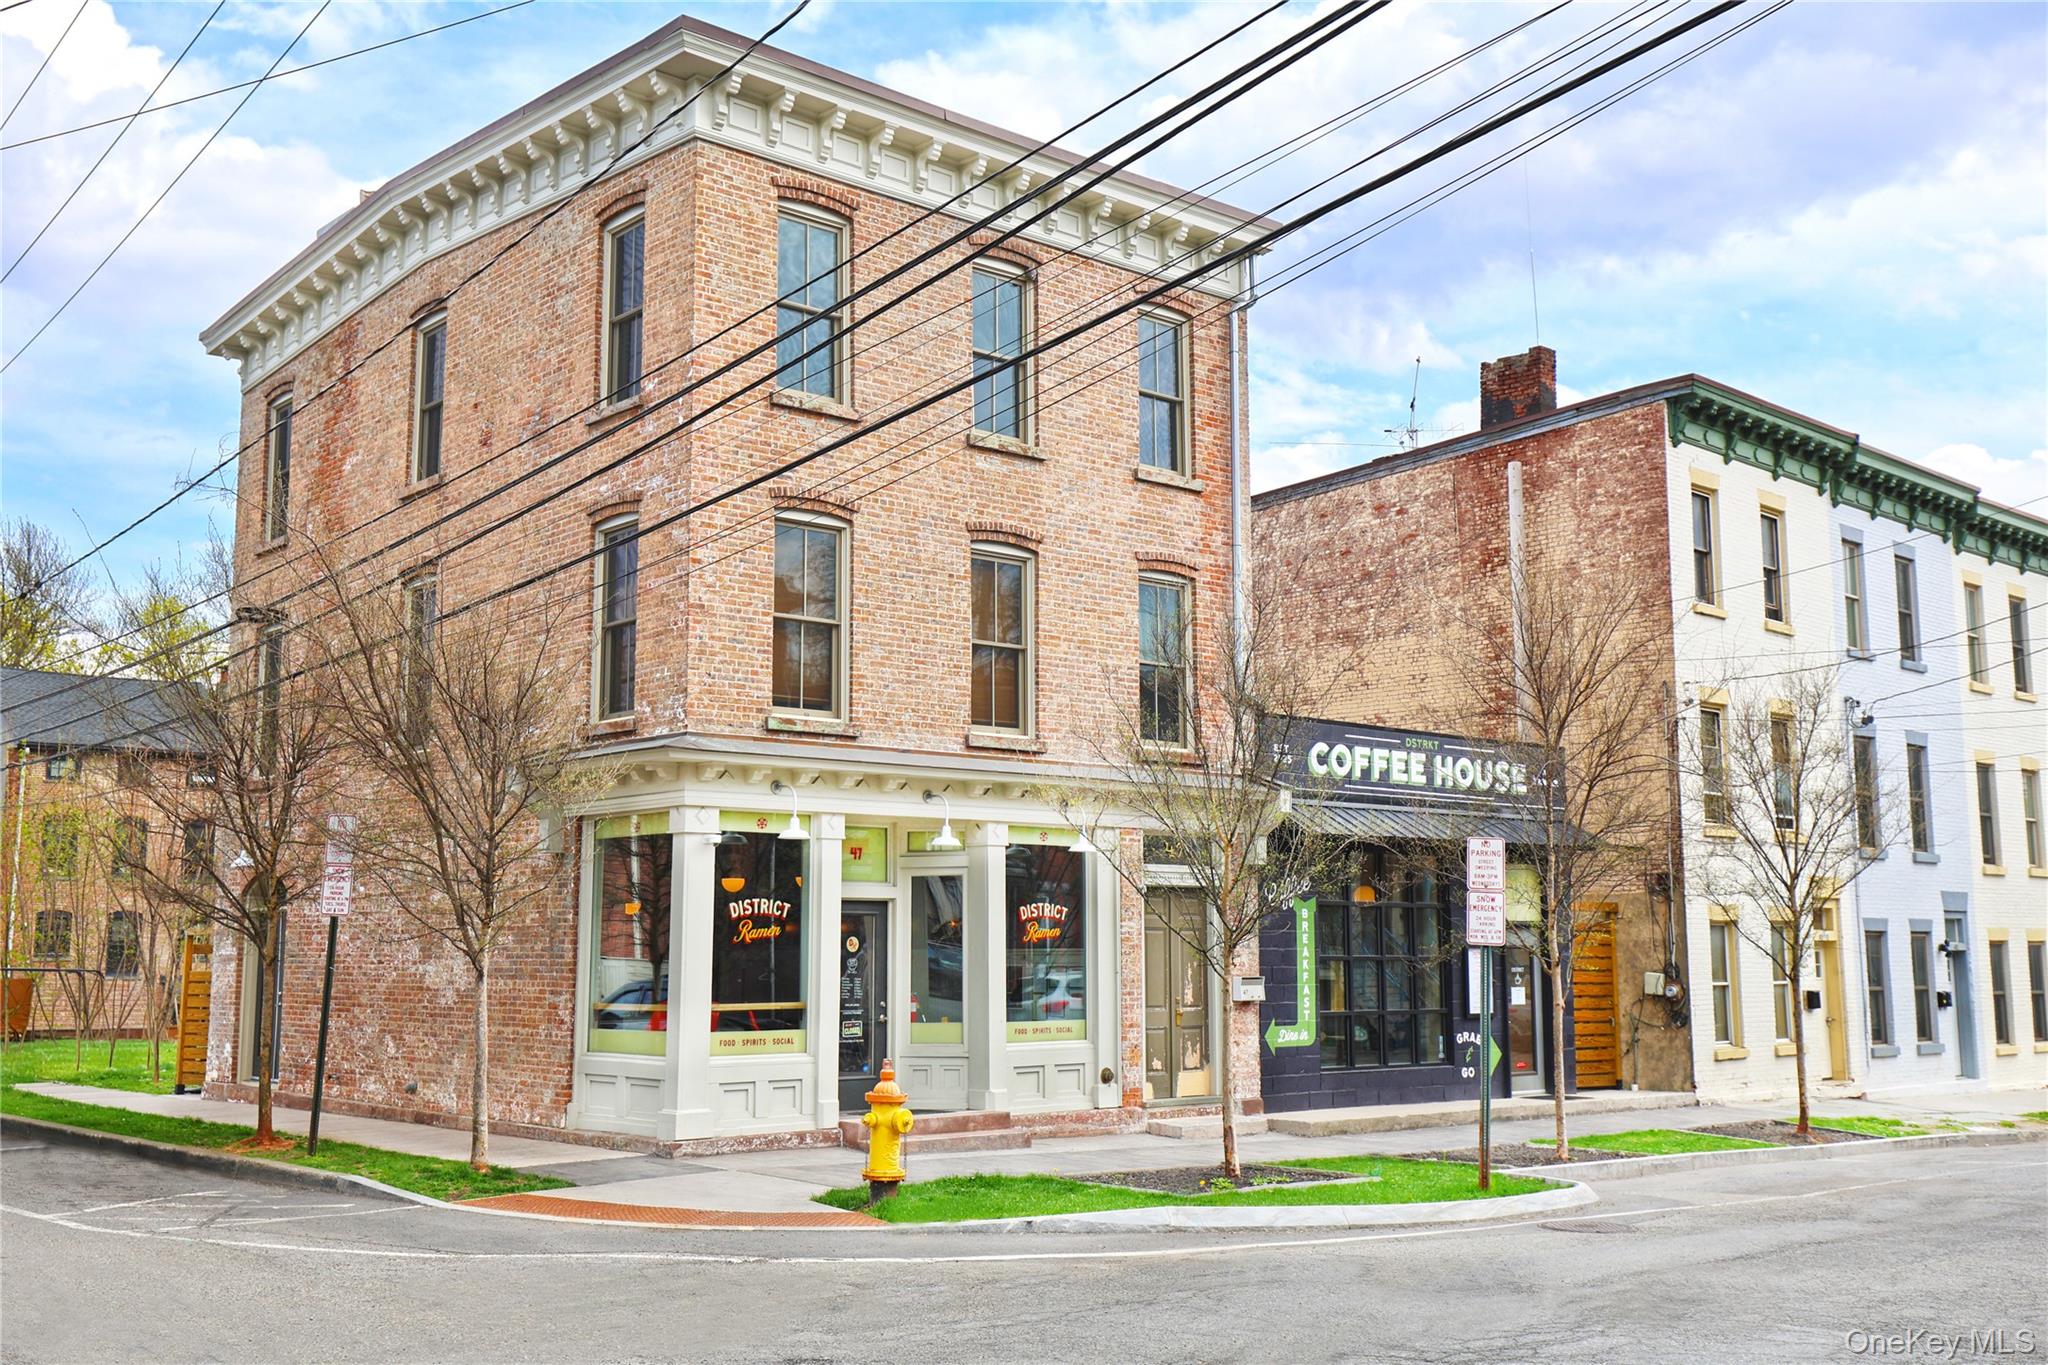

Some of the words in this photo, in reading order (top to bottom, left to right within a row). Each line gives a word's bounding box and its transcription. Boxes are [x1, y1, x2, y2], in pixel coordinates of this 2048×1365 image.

[1405, 737, 1439, 750] DSTRKT
[1308, 741, 1427, 786] COFFEE
[1433, 754, 1528, 795] HOUSE
[1480, 840, 1491, 849] NO
[849, 847, 863, 861] 47
[1470, 849, 1502, 858] PARKING
[1475, 894, 1496, 903] SNOW
[729, 898, 792, 919] DISTRICT
[1019, 902, 1069, 921] DISTRICT
[1469, 904, 1503, 913] EMERGENCY
[732, 919, 782, 944] Ramen
[1023, 921, 1063, 943] Ramen
[1301, 907, 1311, 1022] BREAKFAST
[719, 1039, 736, 1047] FOOD
[742, 1038, 767, 1046] SPIRITS
[772, 1037, 795, 1045] SOCIAL
[1277, 1029, 1299, 1043] Dine
[1299, 1028, 1310, 1041] in
[1456, 1031, 1481, 1045] GRAB
[1461, 1066, 1475, 1078] GO
